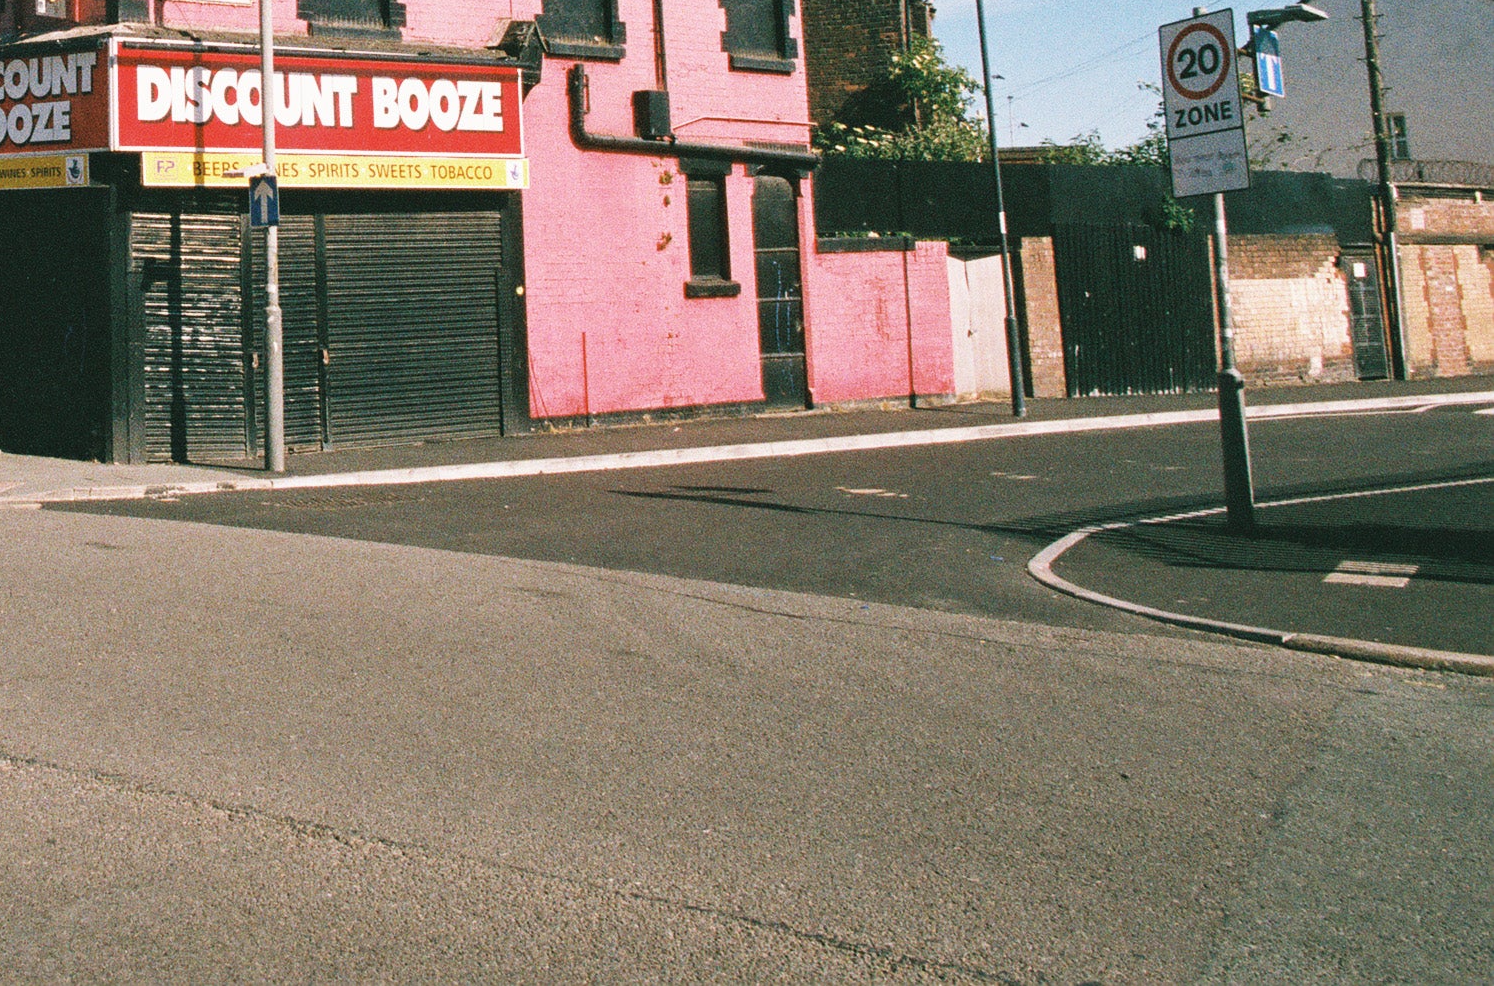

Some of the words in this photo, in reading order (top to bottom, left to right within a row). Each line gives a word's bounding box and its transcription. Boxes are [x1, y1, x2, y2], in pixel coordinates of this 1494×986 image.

[1177, 43, 1220, 80] 20
[137, 65, 358, 128] DISCOUNT
[372, 77, 504, 132] BOOZE
[1174, 100, 1233, 129] ZONE
[0, 167, 26, 180] WINES
[30, 166, 62, 178] SPIRITS
[193, 161, 240, 177] BEERS
[308, 163, 359, 179] SPIRITS
[368, 163, 422, 179] SWEETS
[430, 164, 493, 180] TOBACCO
